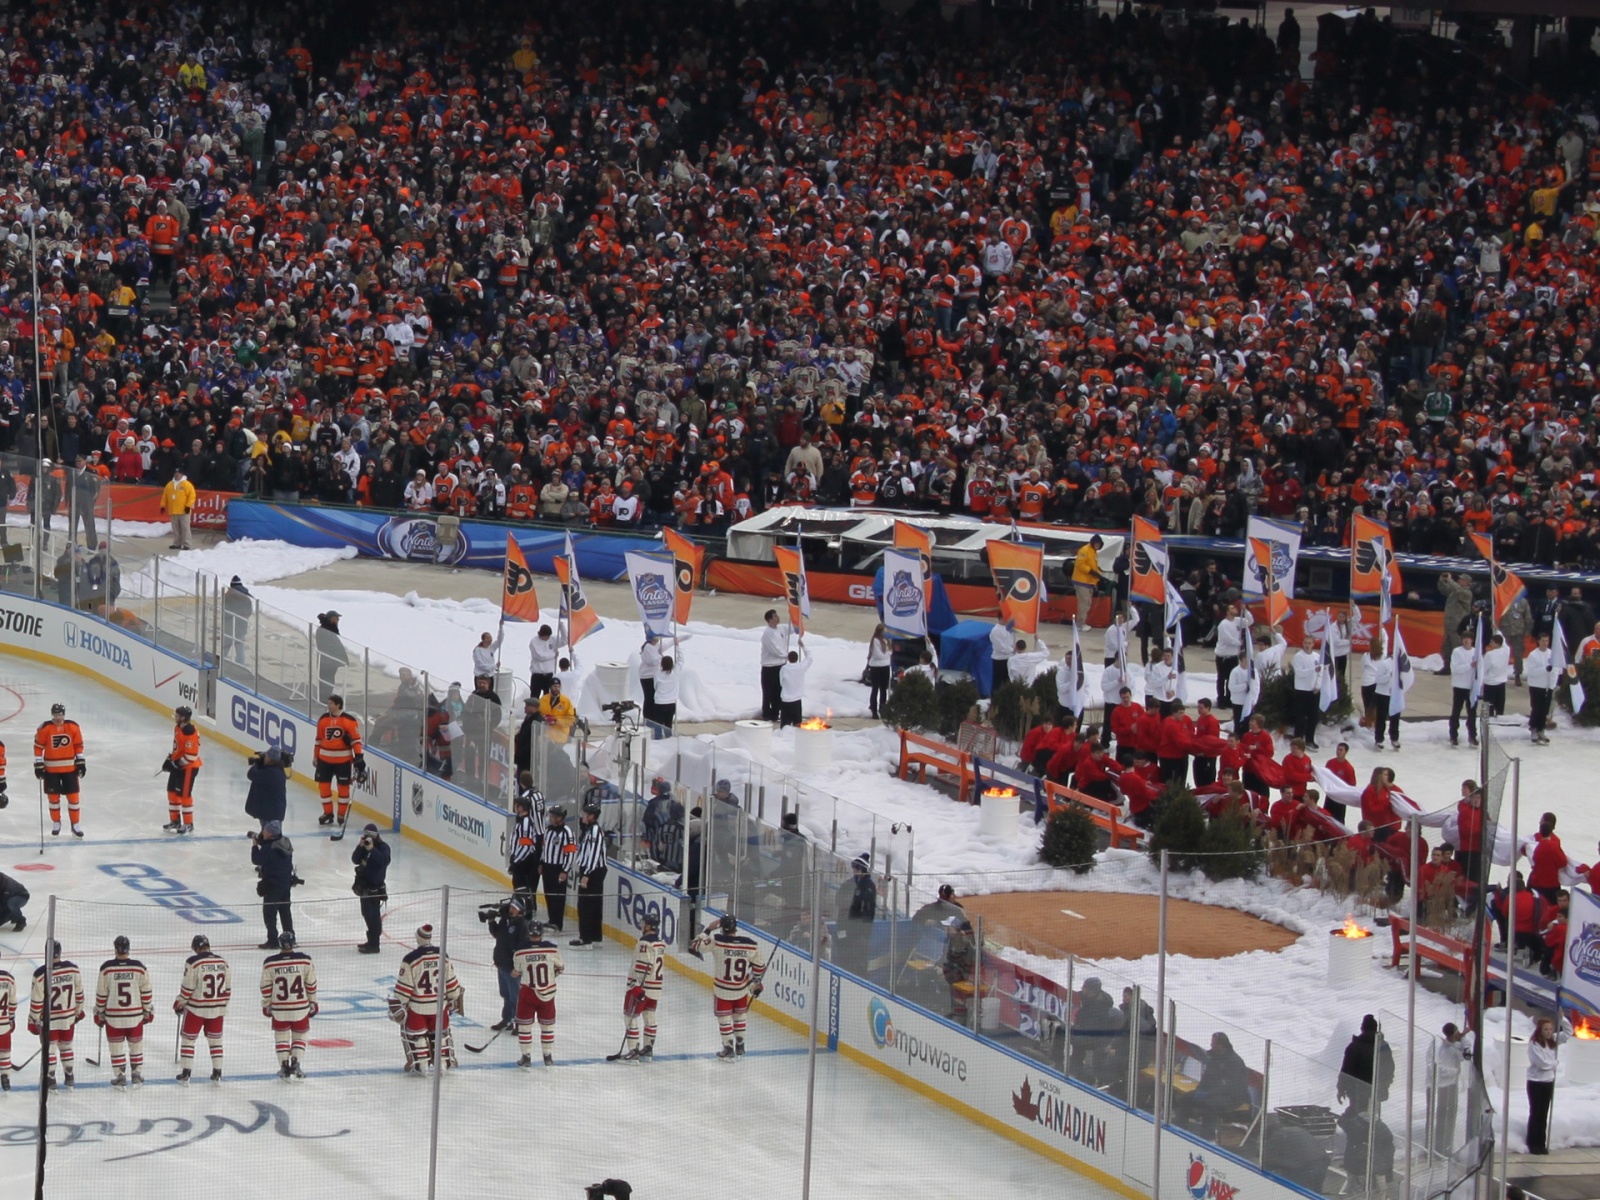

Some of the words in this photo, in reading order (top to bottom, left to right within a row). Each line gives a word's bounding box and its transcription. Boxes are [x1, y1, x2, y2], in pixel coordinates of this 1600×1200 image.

[80, 630, 133, 670] HONDA
[231, 694, 297, 756] GEICO
[96, 863, 245, 924] GEICO
[724, 949, 748, 957] RICHARDS
[274, 966, 300, 975] MITCHELL
[527, 963, 549, 988] 10
[723, 957, 747, 982] 19
[117, 982, 131, 1007] 5
[203, 973, 227, 998] 32
[275, 975, 304, 1000] 34
[774, 981, 806, 1010] CISCO
[829, 975, 839, 1037] Reebok
[872, 1007, 967, 1083] Compuware
[1039, 1079, 1061, 1096] MOLSON
[1036, 1091, 1107, 1155] CANADIAN
